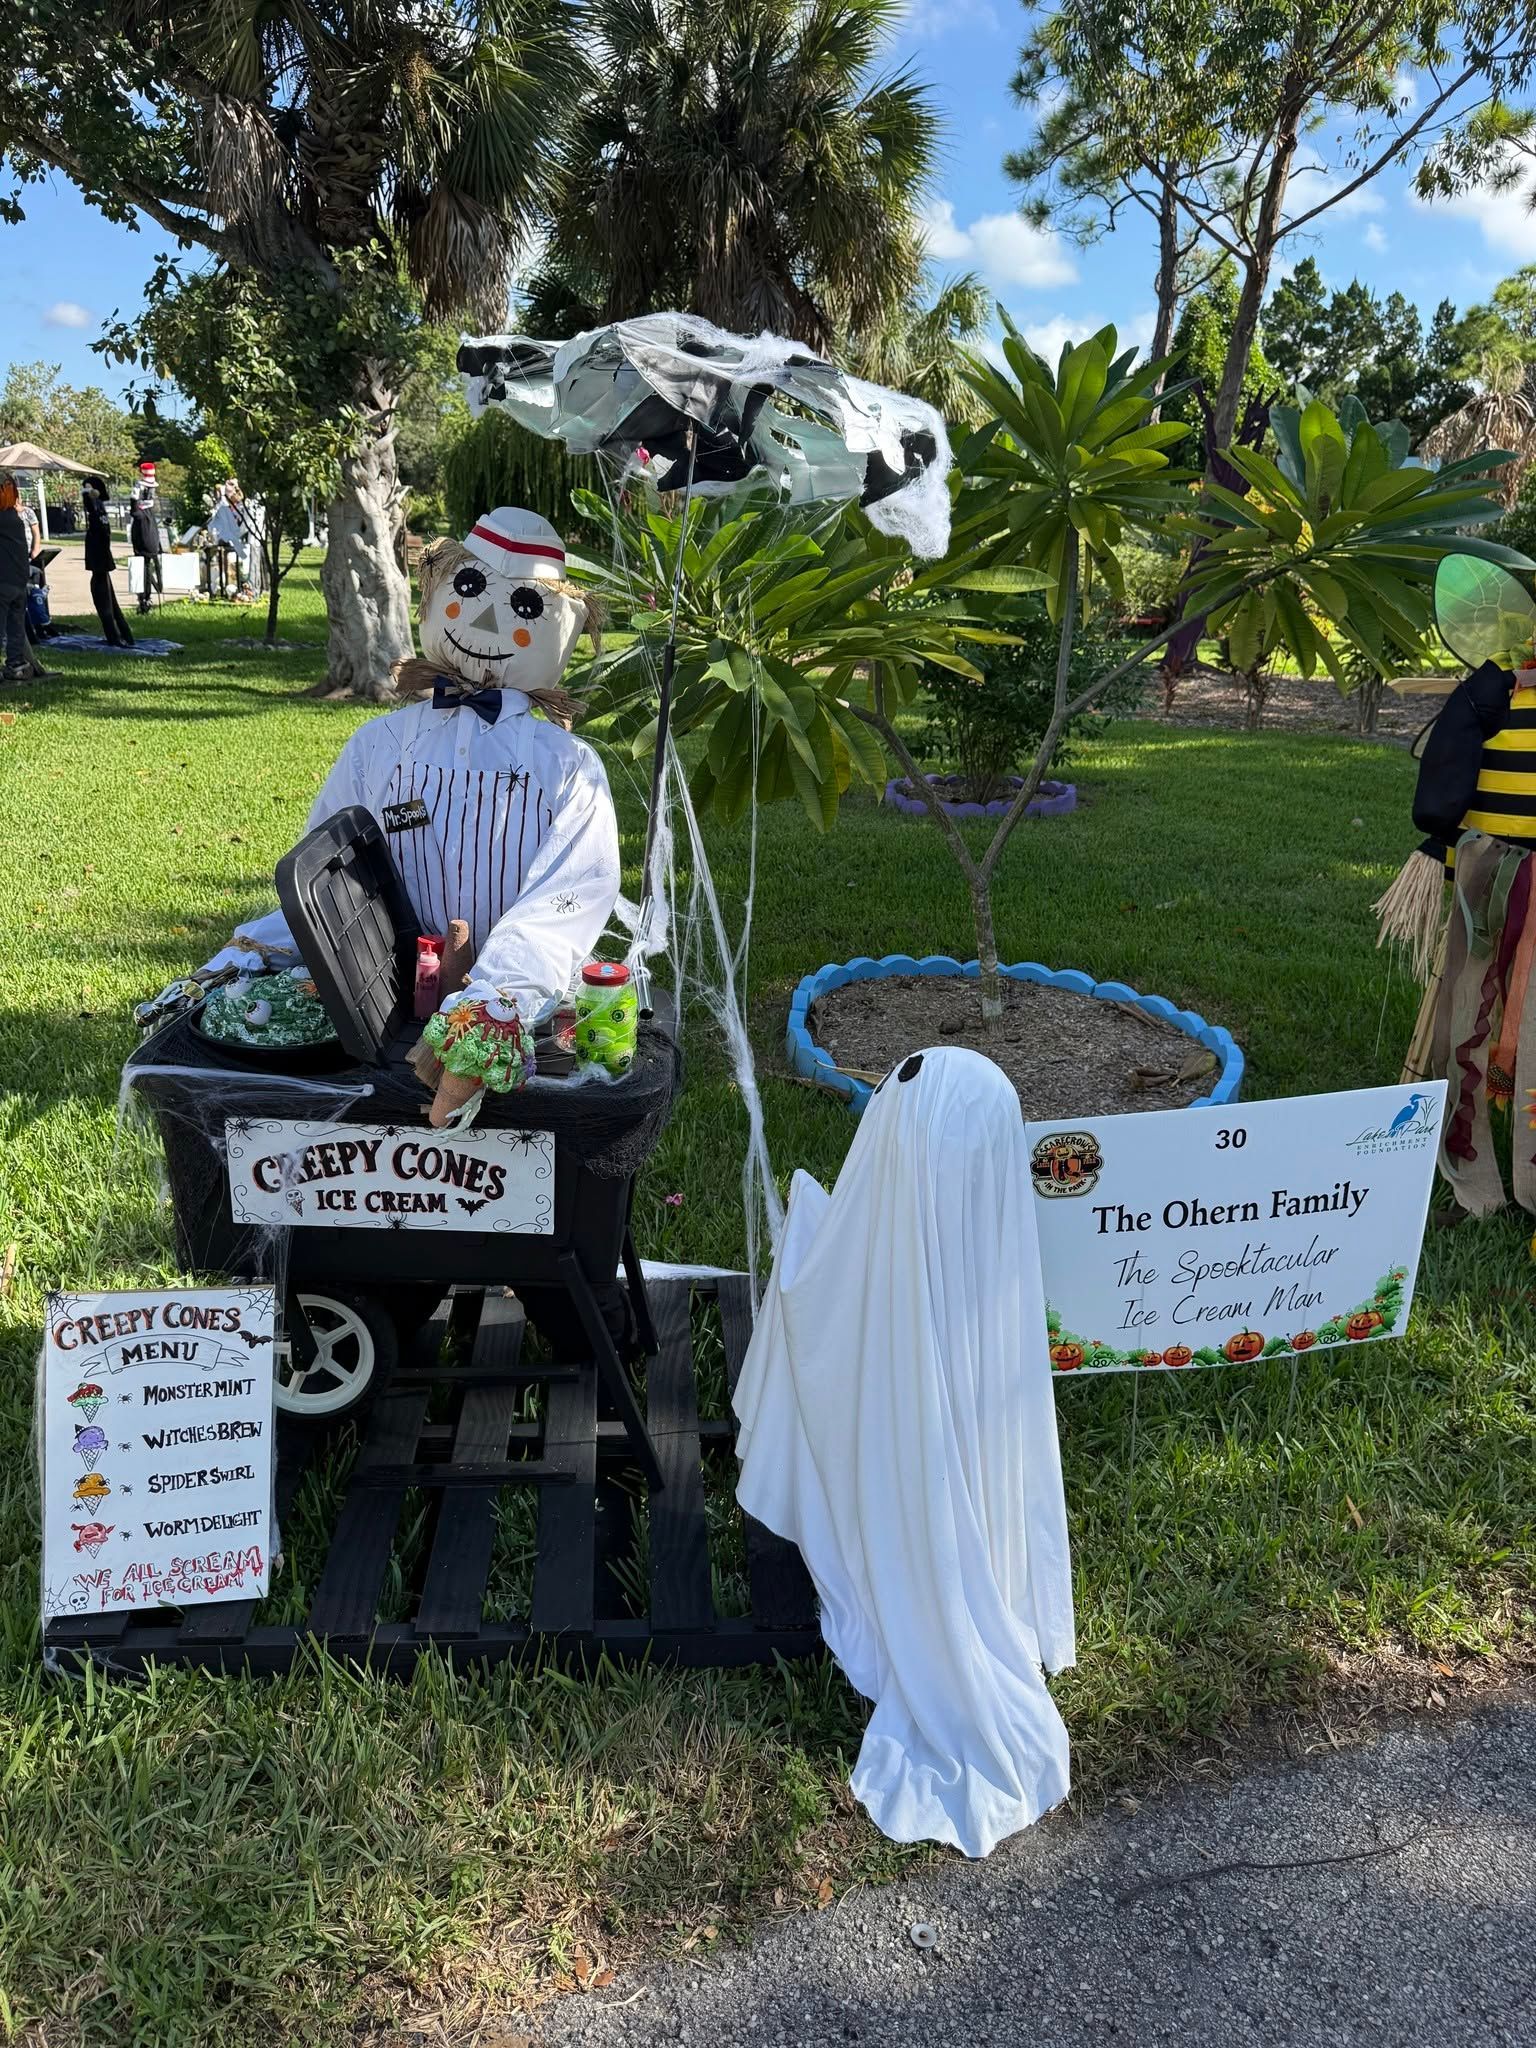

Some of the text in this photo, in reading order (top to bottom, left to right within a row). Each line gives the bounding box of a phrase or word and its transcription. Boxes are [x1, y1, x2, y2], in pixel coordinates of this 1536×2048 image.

[385, 810, 401, 828] Mr.
[1040, 1136, 1094, 1154] SCARECROWS
[1215, 1128, 1247, 1150] 30
[1345, 1120, 1439, 1146] Lakes Park
[1357, 1137, 1428, 1150] ENRICHMENT
[1356, 1143, 1427, 1156] FOUNDATION
[391, 1142, 507, 1201] CONES
[1054, 1186, 1068, 1194] THE
[1068, 1180, 1085, 1193] PARK
[316, 1189, 449, 1213] ICE CREAM
[1092, 1181, 1370, 1234] The Ohern Family
[1113, 1234, 1340, 1293] The Spooktacular
[1116, 1283, 1325, 1331] Ice Cream Man
[53, 1301, 242, 1350] CREEPY CONES
[121, 1341, 199, 1366] MENU
[73, 1545, 264, 1592] WE ALL SCREAM
[101, 1570, 245, 1606] FOR ICE CREAM
